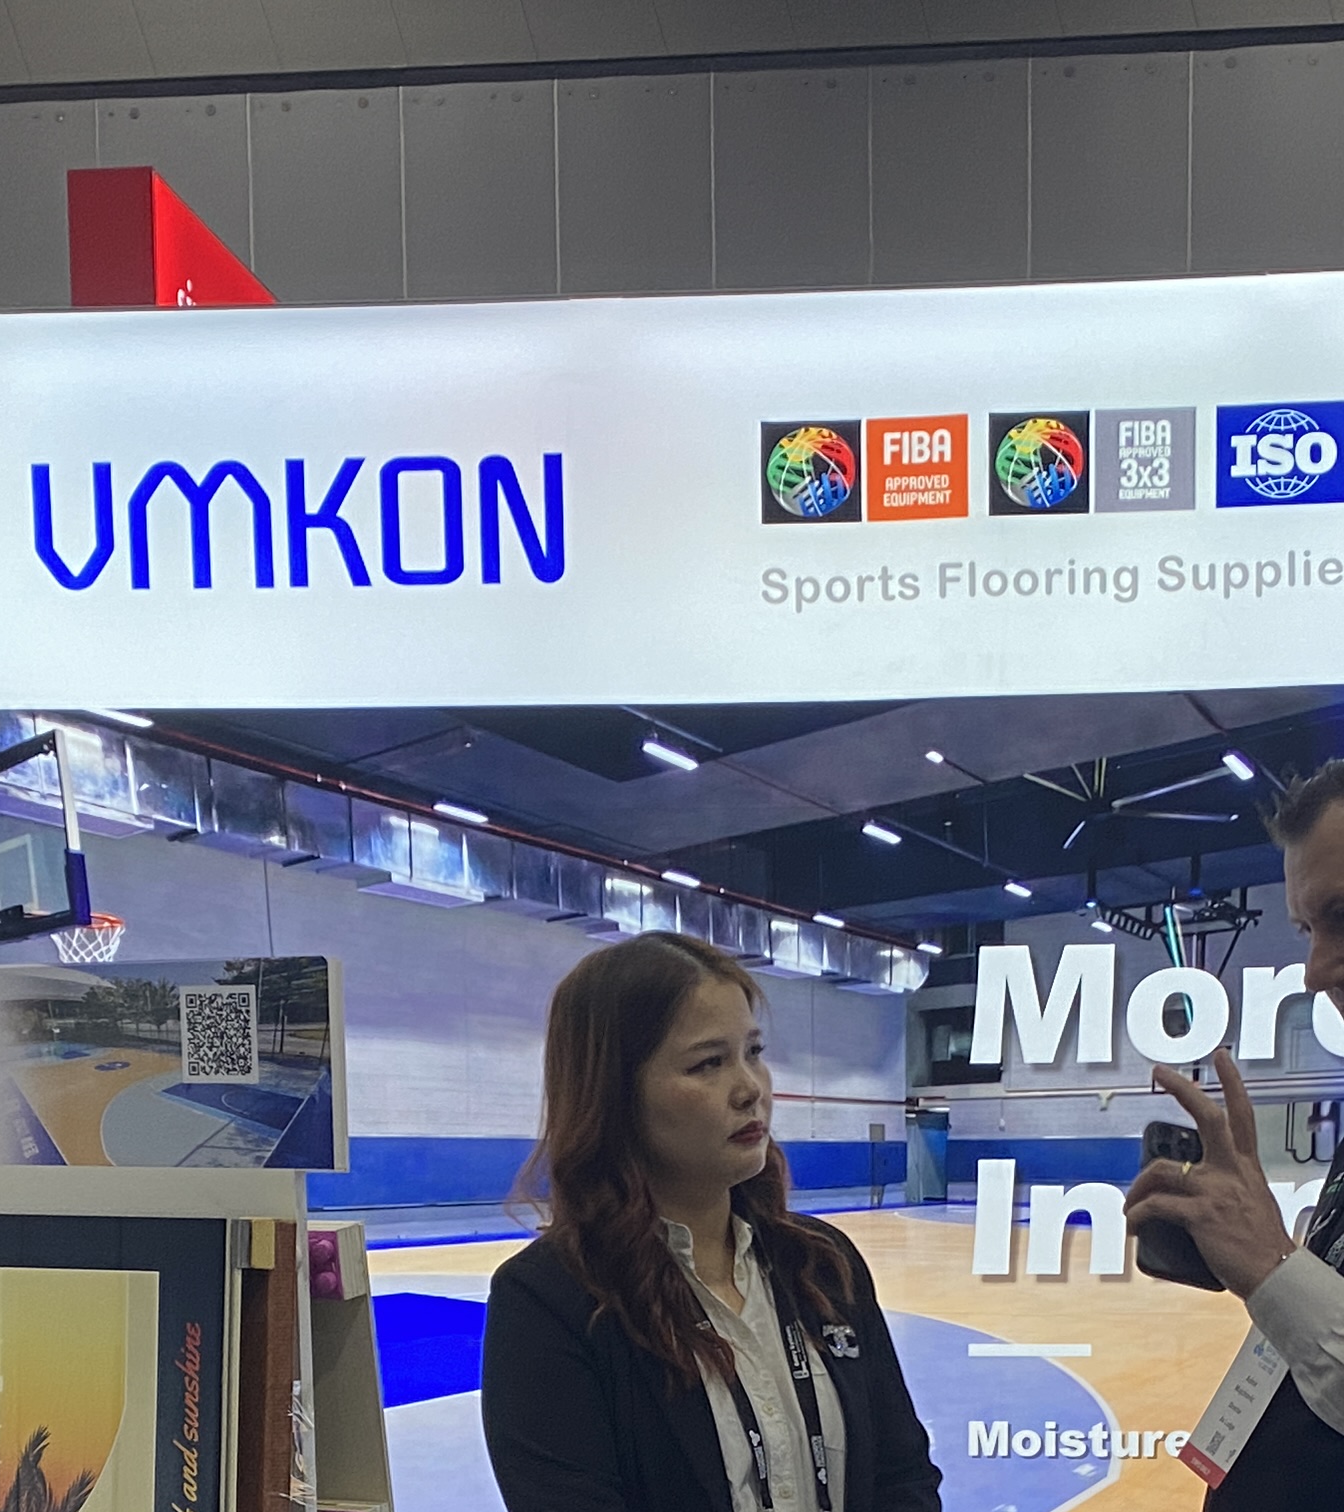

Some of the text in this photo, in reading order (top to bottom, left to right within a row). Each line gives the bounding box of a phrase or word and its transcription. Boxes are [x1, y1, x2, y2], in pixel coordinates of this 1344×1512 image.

[883, 428, 952, 466] FIBA
[1119, 420, 1171, 446] FIBA
[1119, 446, 1171, 459] APPROVED
[1230, 431, 1338, 479] ISO
[885, 474, 950, 491] APPROVED
[1120, 457, 1170, 488] 3x3
[883, 489, 952, 507] EQUIPMENT
[1119, 488, 1171, 500] EQUIPMENT
[761, 566, 920, 613] Sports
[939, 559, 1139, 604] Flooring
[175, 1322, 202, 1443] sunshine
[173, 1439, 199, 1503] and
